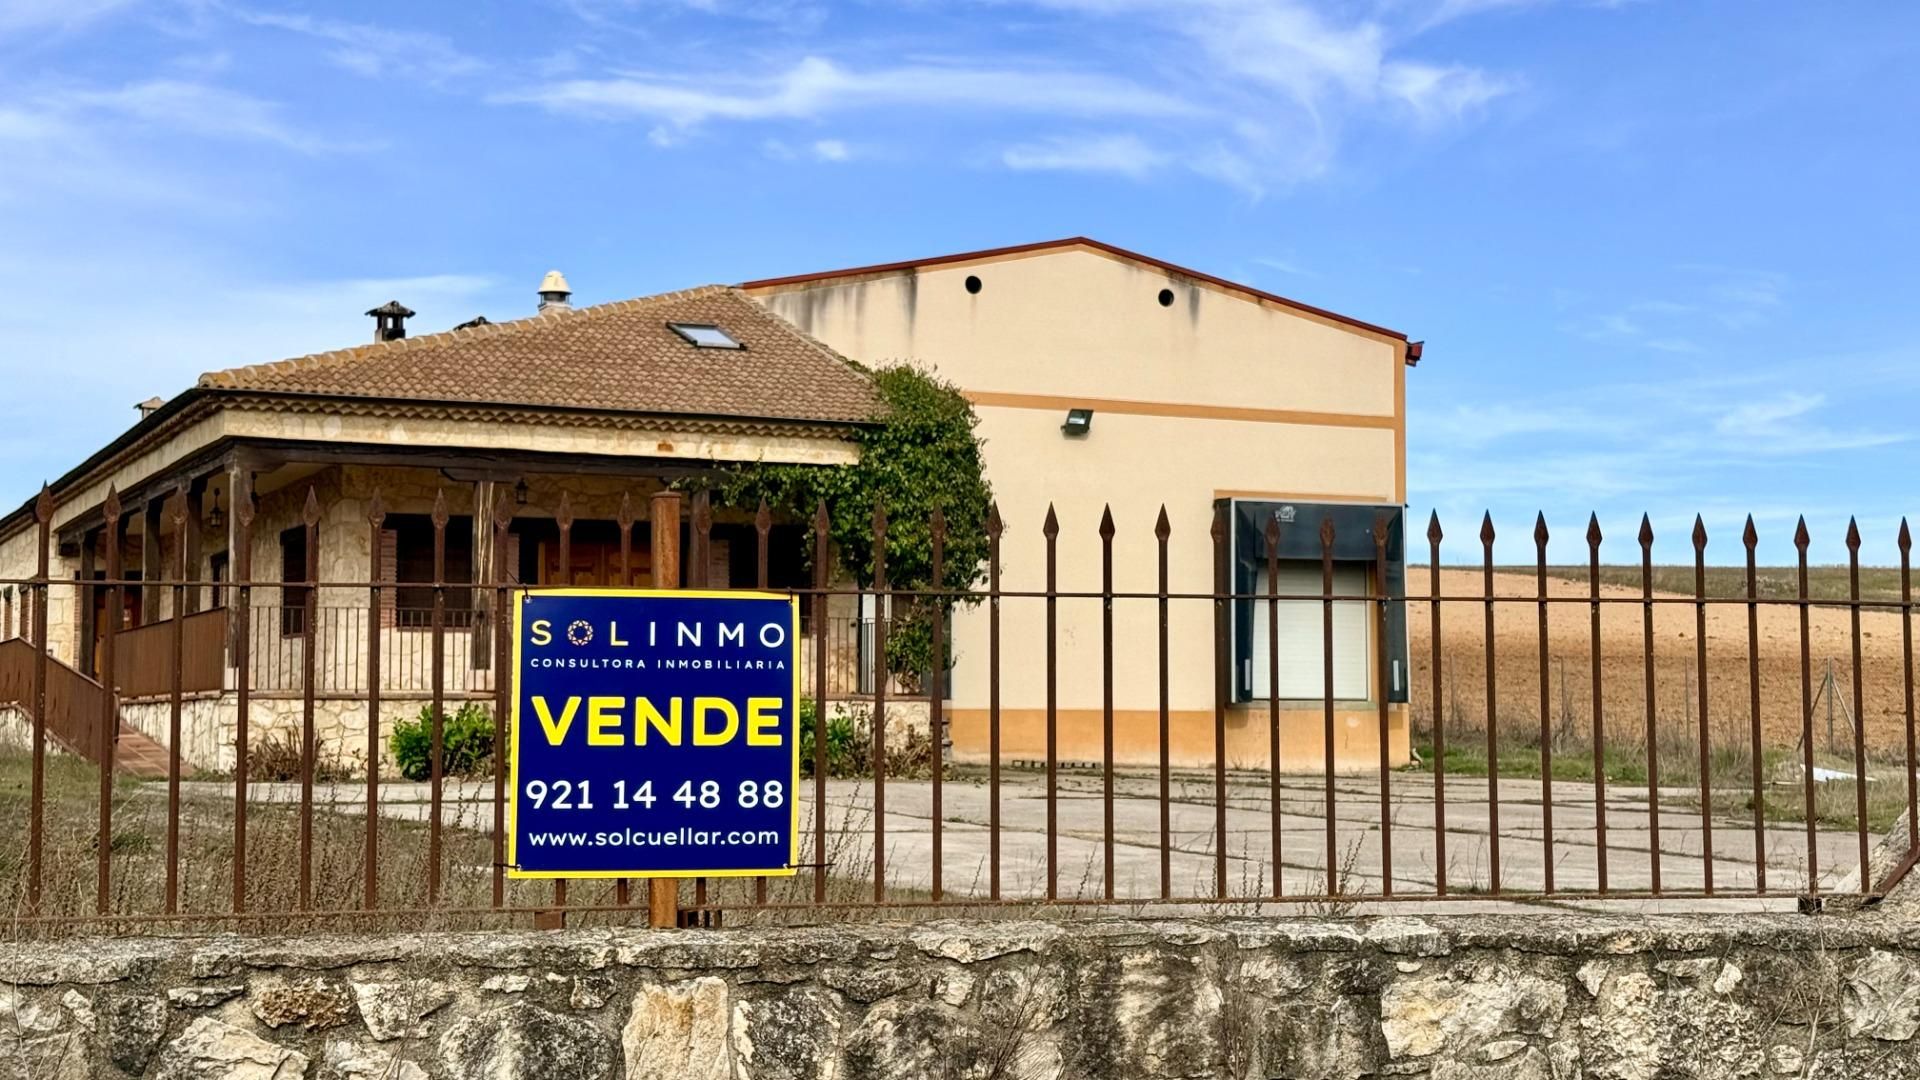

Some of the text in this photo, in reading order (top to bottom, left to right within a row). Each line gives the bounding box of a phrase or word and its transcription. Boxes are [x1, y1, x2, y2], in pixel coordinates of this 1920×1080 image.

[530, 619, 785, 648] SOLINMO
[530, 658, 785, 670] CONSULTORA INMOBILIARIA
[531, 696, 782, 746] VENDE
[526, 780, 783, 809] 921 14 48 88
[528, 827, 779, 846] www.solcuellar.com
